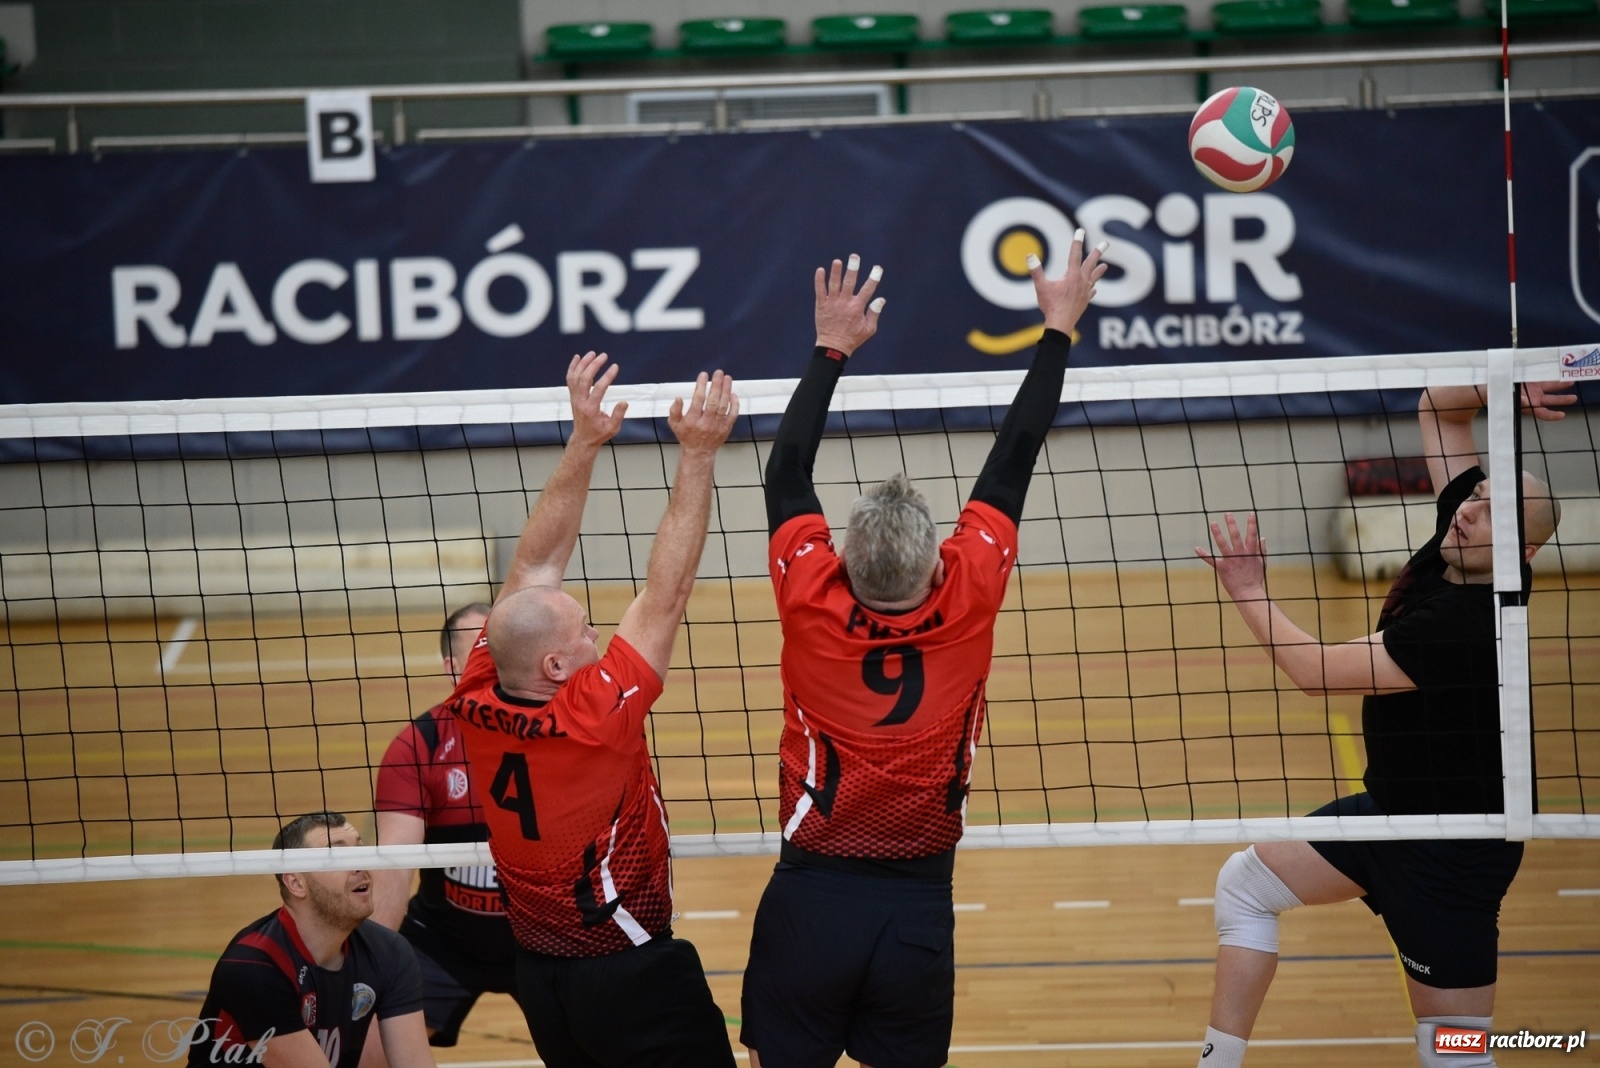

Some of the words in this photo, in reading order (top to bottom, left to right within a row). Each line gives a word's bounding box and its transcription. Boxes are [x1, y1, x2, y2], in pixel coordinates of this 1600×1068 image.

[318, 111, 363, 160] B
[111, 224, 704, 349] RACIBÓRZ
[1100, 305, 1304, 349] RACIBÓRZ
[447, 696, 568, 741] RZEGORZ
[861, 644, 925, 728] 9
[489, 752, 541, 840] 4
